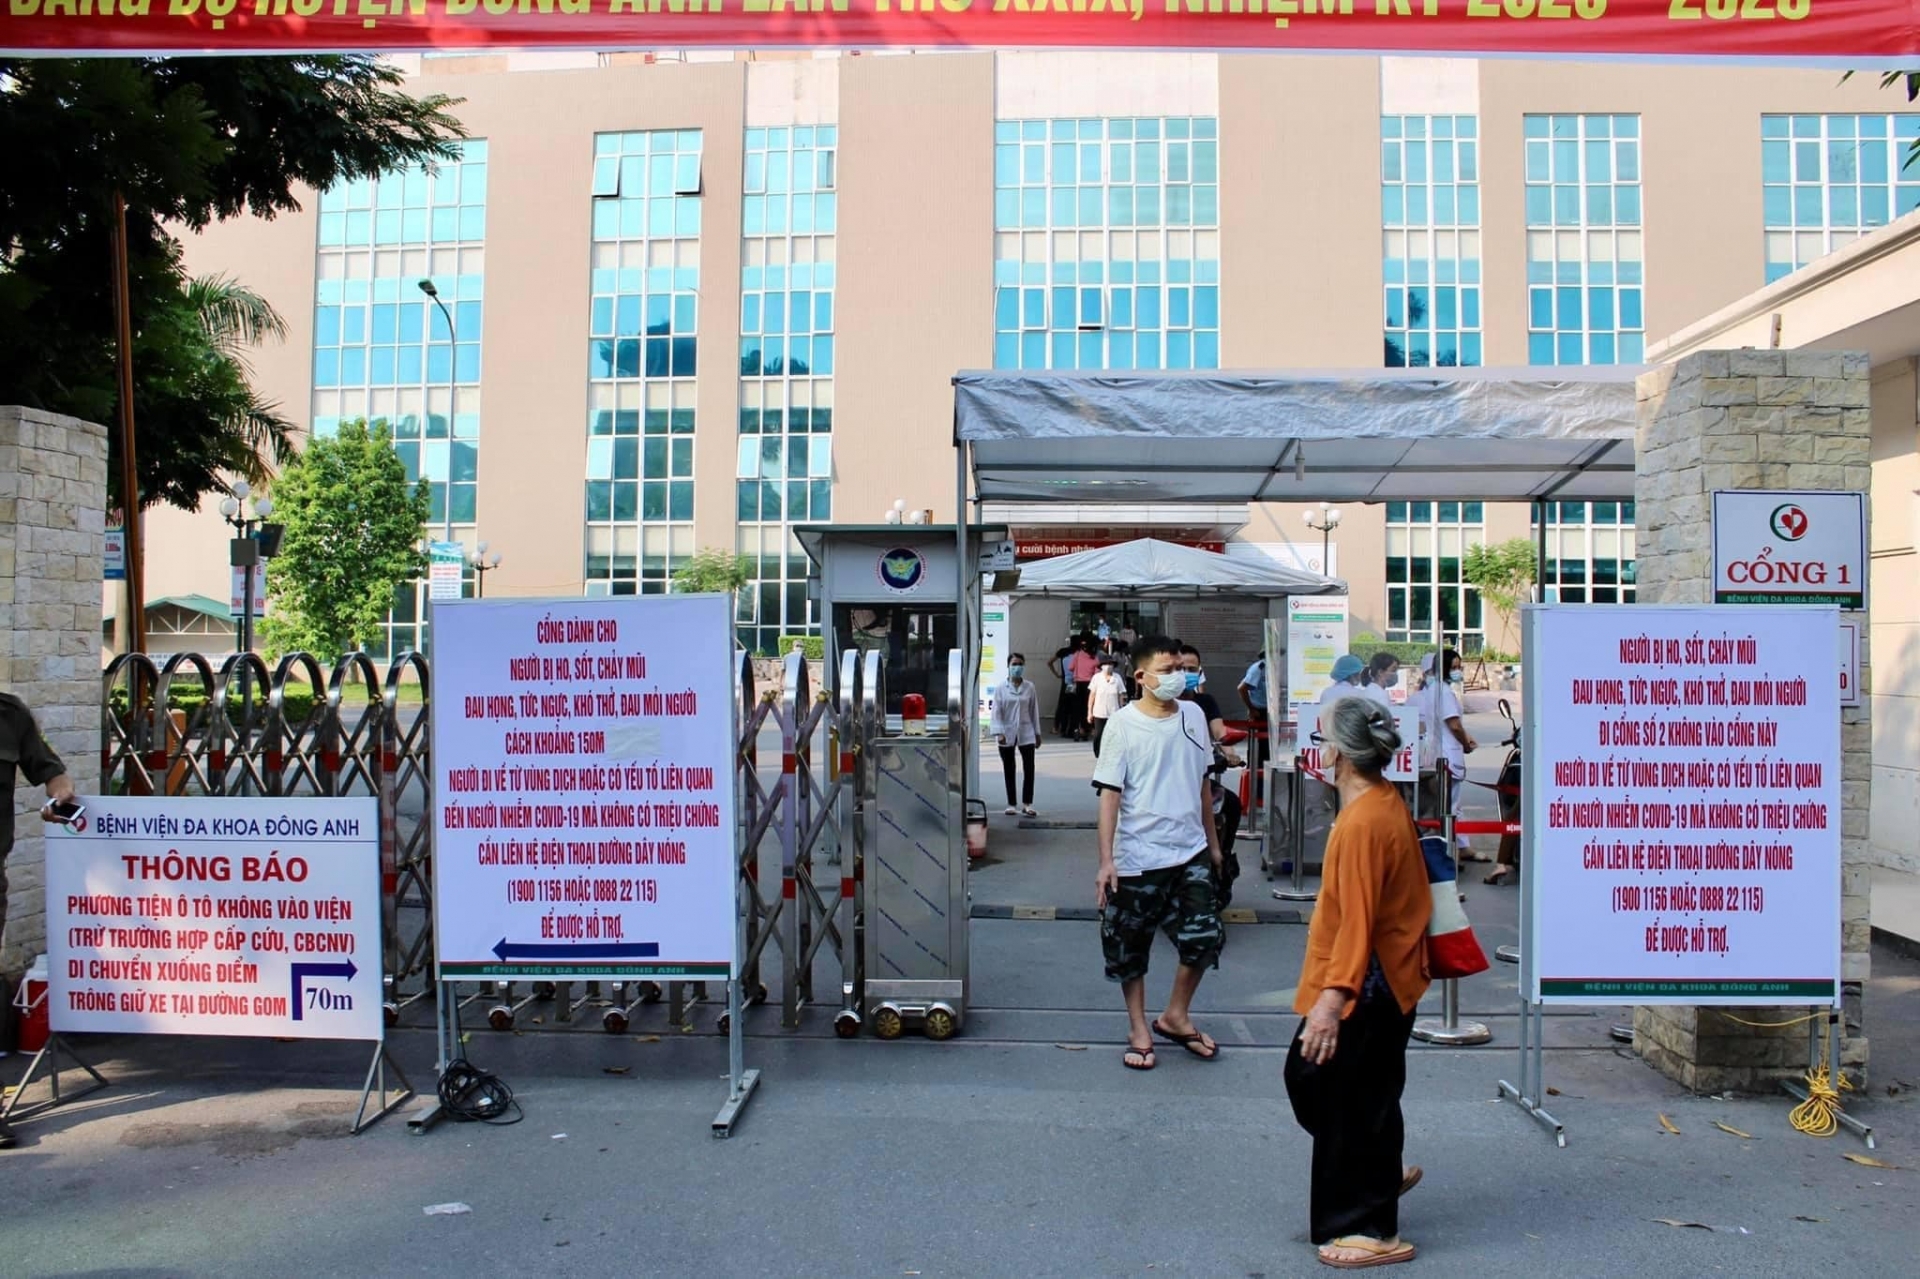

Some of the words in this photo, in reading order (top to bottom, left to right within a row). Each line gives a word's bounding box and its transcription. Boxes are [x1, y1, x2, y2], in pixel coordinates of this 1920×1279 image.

[1045, 544, 1069, 556] bệnh
[1727, 547, 1827, 584] CỔNG
[1838, 565, 1850, 584] 1
[537, 611, 564, 643] CỔNG
[567, 615, 594, 643] DÀNH
[597, 620, 617, 642] CHO
[510, 653, 540, 680] NGƯỜI
[543, 658, 553, 686] BỊ
[556, 658, 572, 684] HO,
[575, 649, 595, 684] SỐT,
[598, 649, 623, 679] CHẢY
[626, 652, 645, 679] MŨI
[1620, 635, 1650, 664] NGƯỜI
[1653, 640, 1663, 670] BỊ
[1666, 640, 1682, 668] HO,
[1685, 632, 1705, 668] SỐT,
[1708, 632, 1734, 664] CHẢY
[1737, 635, 1756, 664] MŨI
[465, 696, 484, 718] ĐAU
[487, 696, 517, 724] HỌNG,
[519, 690, 538, 718] TỨC
[541, 692, 571, 723] NGỰC,
[574, 689, 593, 717] KHÓ
[596, 686, 618, 720] THỞ,
[621, 694, 640, 716] ĐAU
[643, 686, 663, 716] MỎI
[665, 688, 696, 715] NGƯỜI
[1573, 681, 1593, 705] ĐAU
[1596, 681, 1626, 711] HỌNG,
[1629, 676, 1647, 705] TỨC
[1651, 679, 1681, 711] NGỰC,
[1684, 676, 1704, 705] KHÓ
[1706, 673, 1728, 709] THỞ,
[1731, 681, 1750, 705] ĐAU
[1754, 673, 1773, 705] MỎI
[1776, 677, 1806, 706] NGƯỜI
[505, 727, 532, 754] CÁCH
[534, 724, 575, 754] KHOẢNG
[577, 731, 604, 754] 150M
[1599, 722, 1610, 746] ĐI
[1613, 712, 1640, 746] CỔNG
[1643, 714, 1656, 746] SỐ
[1659, 722, 1665, 746] 2
[1668, 717, 1702, 746] KHÔNG
[1705, 717, 1724, 746] VÀO
[1727, 712, 1754, 746] CỔNG
[1757, 718, 1777, 747] NÀY
[1395, 743, 1414, 773] TẾ
[449, 765, 479, 792] NGƯỜI
[482, 769, 492, 792] ĐI
[509, 764, 522, 791] TỪ
[524, 764, 550, 791] VÙNG
[553, 768, 576, 797] DỊCH
[579, 763, 605, 796] HOẶC
[608, 763, 622, 790] CÓ
[624, 759, 643, 790] YẾU
[646, 759, 658, 789] TỐ
[661, 762, 683, 789] LIÊN
[686, 767, 713, 791] QUAN
[96, 813, 137, 838] BỆNH
[142, 814, 178, 838] VIỆN
[183, 818, 208, 834] ĐA
[213, 819, 260, 835] KHOA
[265, 816, 318, 836] ĐÔNG
[323, 820, 359, 837] ANH
[1550, 796, 1570, 828] ĐẾN
[1573, 799, 1603, 828] NGƯỜI
[1607, 794, 1639, 828] NHIỄM
[1642, 805, 1687, 829] COVID-19
[1690, 800, 1706, 829] MÀ
[1709, 800, 1743, 829] KHÔNG
[1746, 800, 1759, 829] CÓ
[1762, 800, 1790, 835] TRIỆU
[1793, 800, 1826, 829] CHỨNG
[121, 849, 230, 881] THÔNG
[242, 850, 308, 882] BÁO
[1607, 841, 1629, 870] LIÊN
[1632, 841, 1645, 876] HỆ
[1647, 841, 1671, 876] ĐIỆN
[1674, 846, 1702, 876] THOẠI
[1705, 841, 1739, 870] ĐƯỜNG
[1742, 841, 1762, 870] DÂY
[1765, 841, 1793, 870] NÓNG
[68, 894, 132, 916] PHƯƠNG
[137, 892, 171, 922] TIỆN
[178, 893, 187, 917] Ô
[193, 893, 212, 917] TÔ
[217, 894, 272, 918] KHÔNG
[277, 895, 309, 919] VÀO
[314, 895, 351, 925] VIỆN
[508, 881, 535, 905] (1900
[538, 880, 562, 903] 1156
[564, 875, 591, 908] HOẶC
[593, 879, 617, 902] 0888
[620, 879, 632, 901] 22
[635, 879, 657, 903] 115)
[1613, 887, 1640, 913] (1900
[1643, 887, 1667, 911] 1156
[1670, 882, 1697, 917] HOẶC
[1699, 887, 1724, 911] 0888
[1726, 887, 1739, 911] 22
[1742, 887, 1763, 913] 115)
[69, 924, 106, 949] (TRỪ
[108, 925, 171, 949] TRƯỜNG
[177, 928, 208, 955] HỢP
[215, 924, 246, 950] CẤP
[251, 927, 288, 954] CỨU,
[294, 933, 354, 953] CBCNV)
[541, 906, 554, 939] ĐỂ
[557, 914, 583, 944] ĐƯỢC
[586, 906, 599, 938] HỖ
[602, 913, 624, 944] TRỢ.
[1646, 918, 1658, 952] ĐỂ
[1661, 925, 1688, 958] ĐƯỢC
[1691, 918, 1704, 952] HỖ
[1707, 926, 1729, 958] TRỢ.
[68, 960, 84, 980] DI
[89, 951, 151, 980] CHUYỂN
[157, 954, 211, 981] XUỐNG
[217, 953, 257, 982] ĐIỂM
[67, 989, 116, 1012] TRÔNG
[120, 990, 146, 1013] GIỮ
[149, 994, 166, 1013] XE
[172, 995, 193, 1019] TẠI
[199, 991, 248, 1014] ĐƯỜNG
[254, 996, 286, 1015] GOM
[305, 987, 353, 1010] 70m
